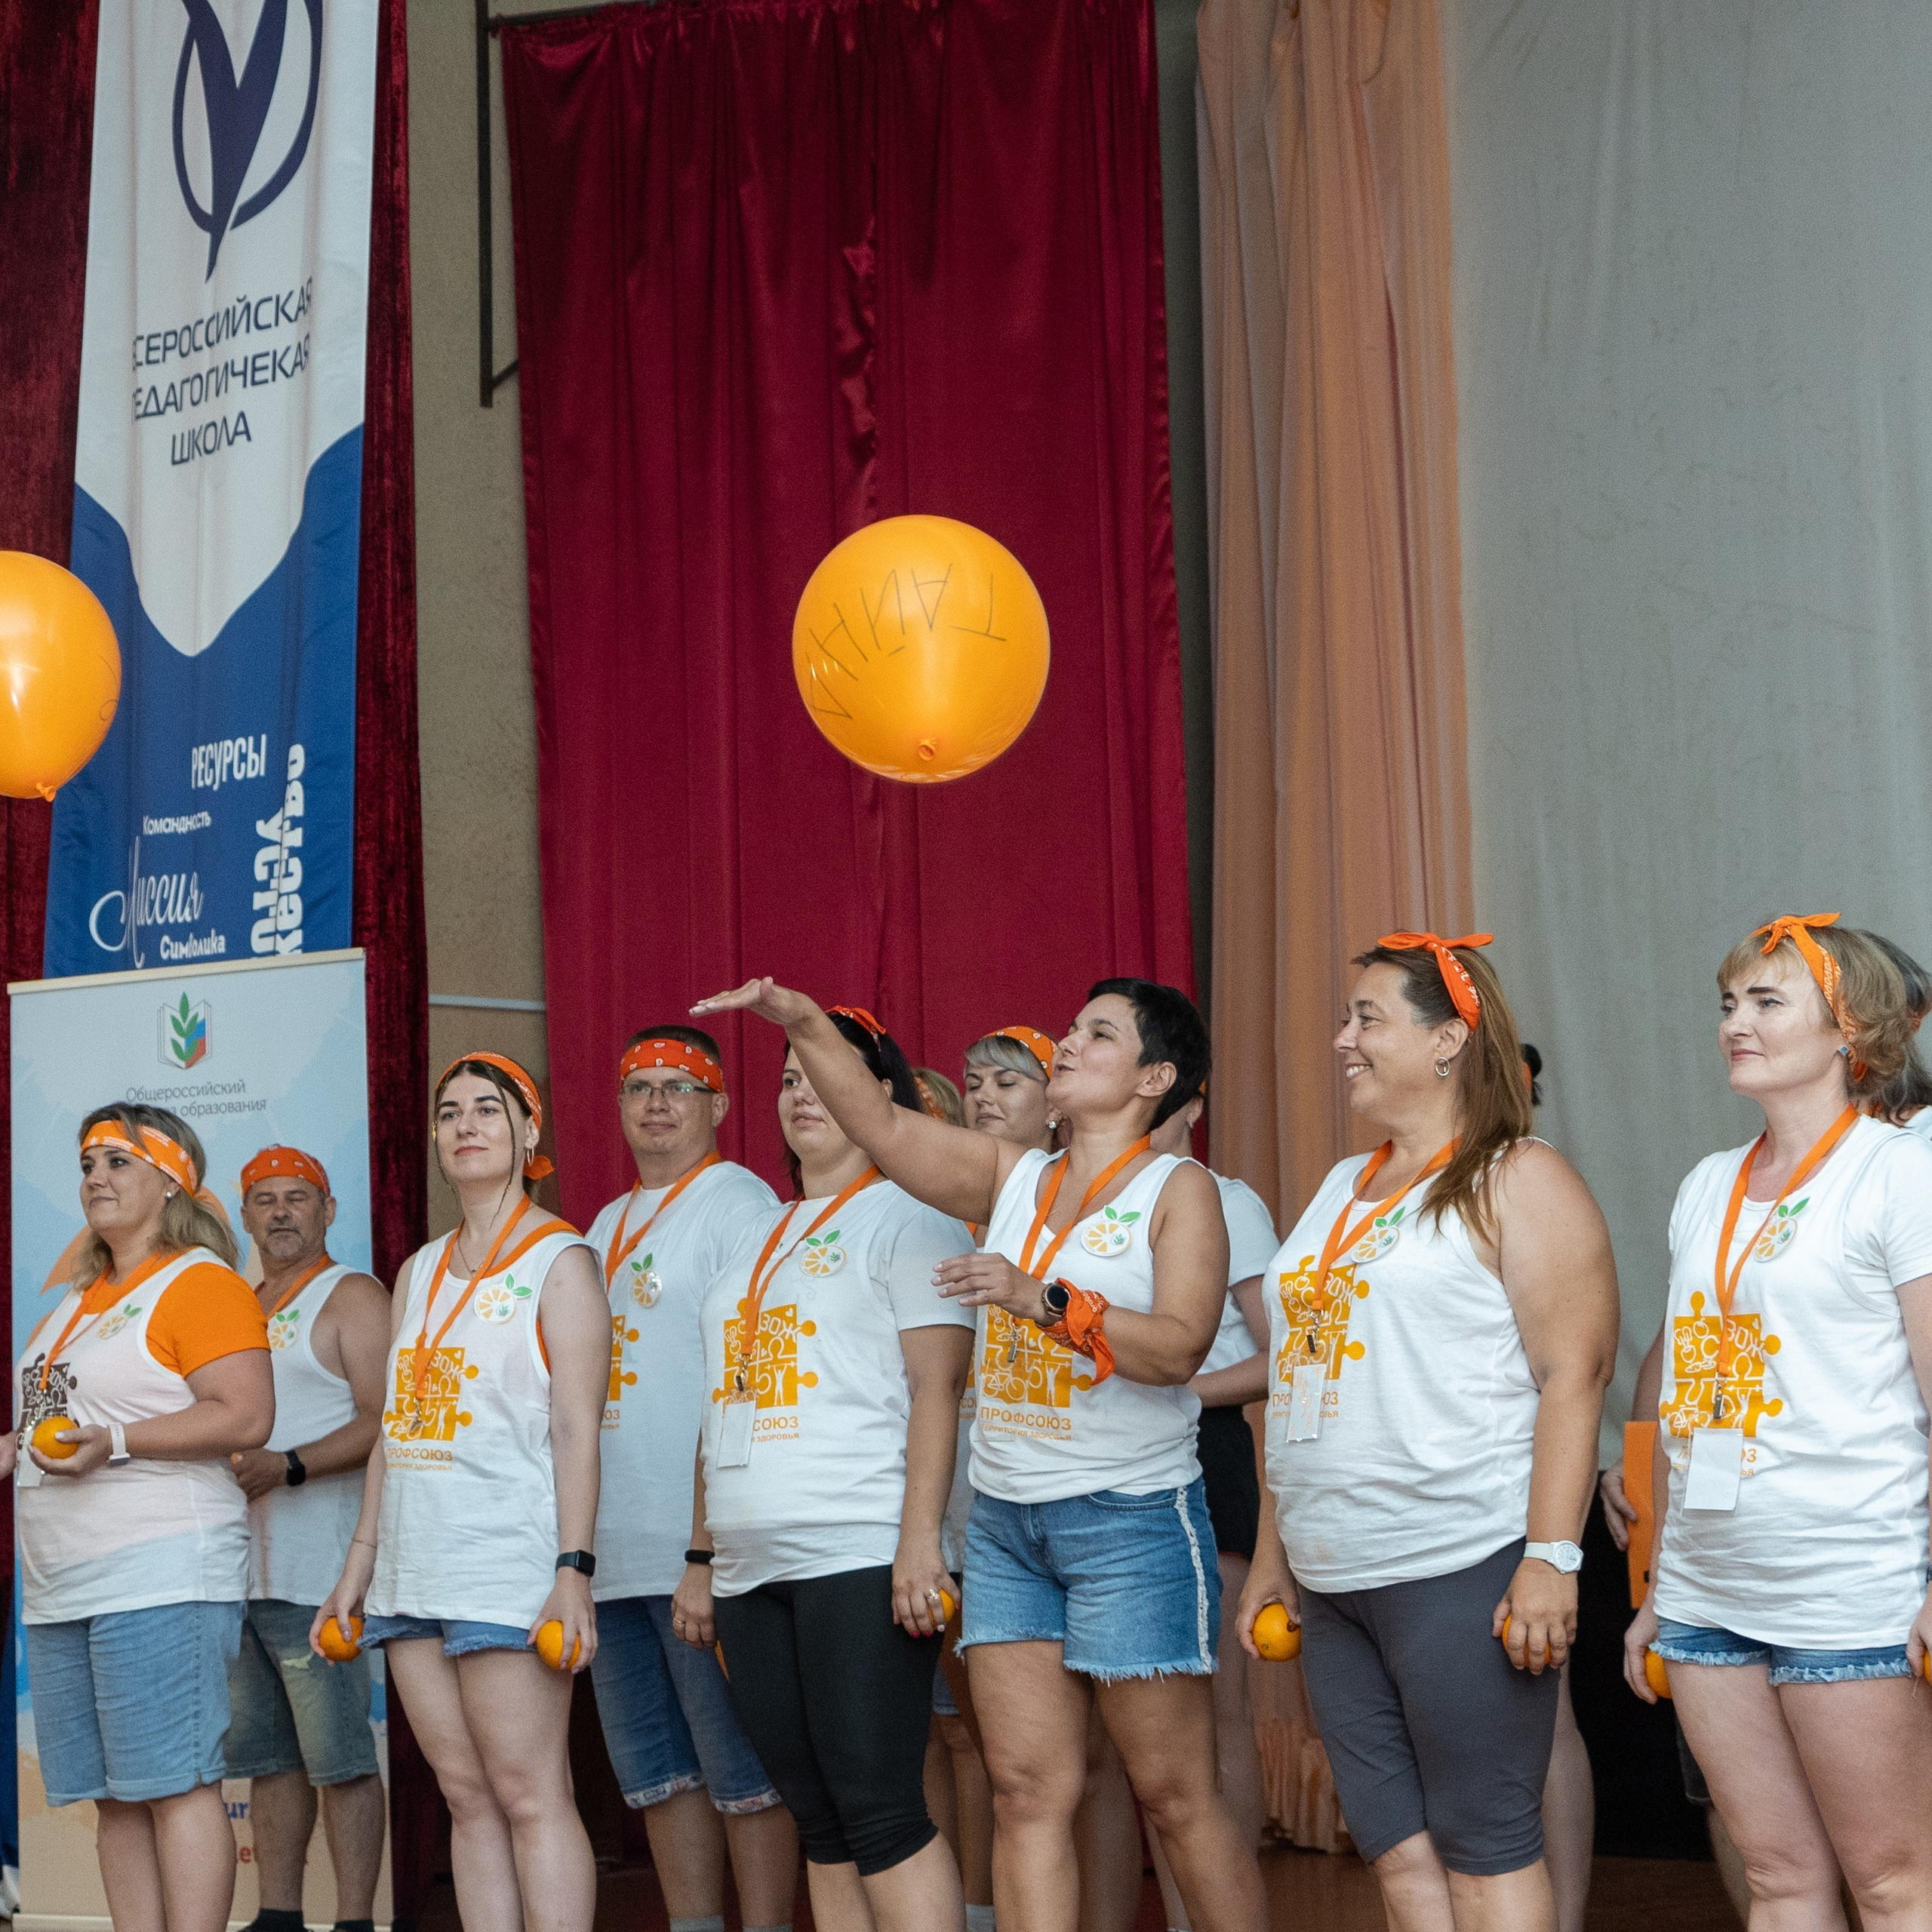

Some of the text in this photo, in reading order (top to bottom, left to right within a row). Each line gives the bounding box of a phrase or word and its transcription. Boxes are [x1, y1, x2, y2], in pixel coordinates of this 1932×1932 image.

[133, 275, 312, 371] СЕРОССИЙСКАЯ
[171, 411, 252, 466] ШКОЛА
[192, 734, 266, 791] РЕСУРСЫ
[143, 811, 211, 835] Командность
[160, 929, 226, 960] Символика
[126, 1079, 246, 1102] Общероссийский
[180, 1100, 266, 1118] образования
[981, 1407, 1072, 1431] ПРОФСОЮЗ
[757, 1433, 800, 1442] ЗДОРОВЬЯ
